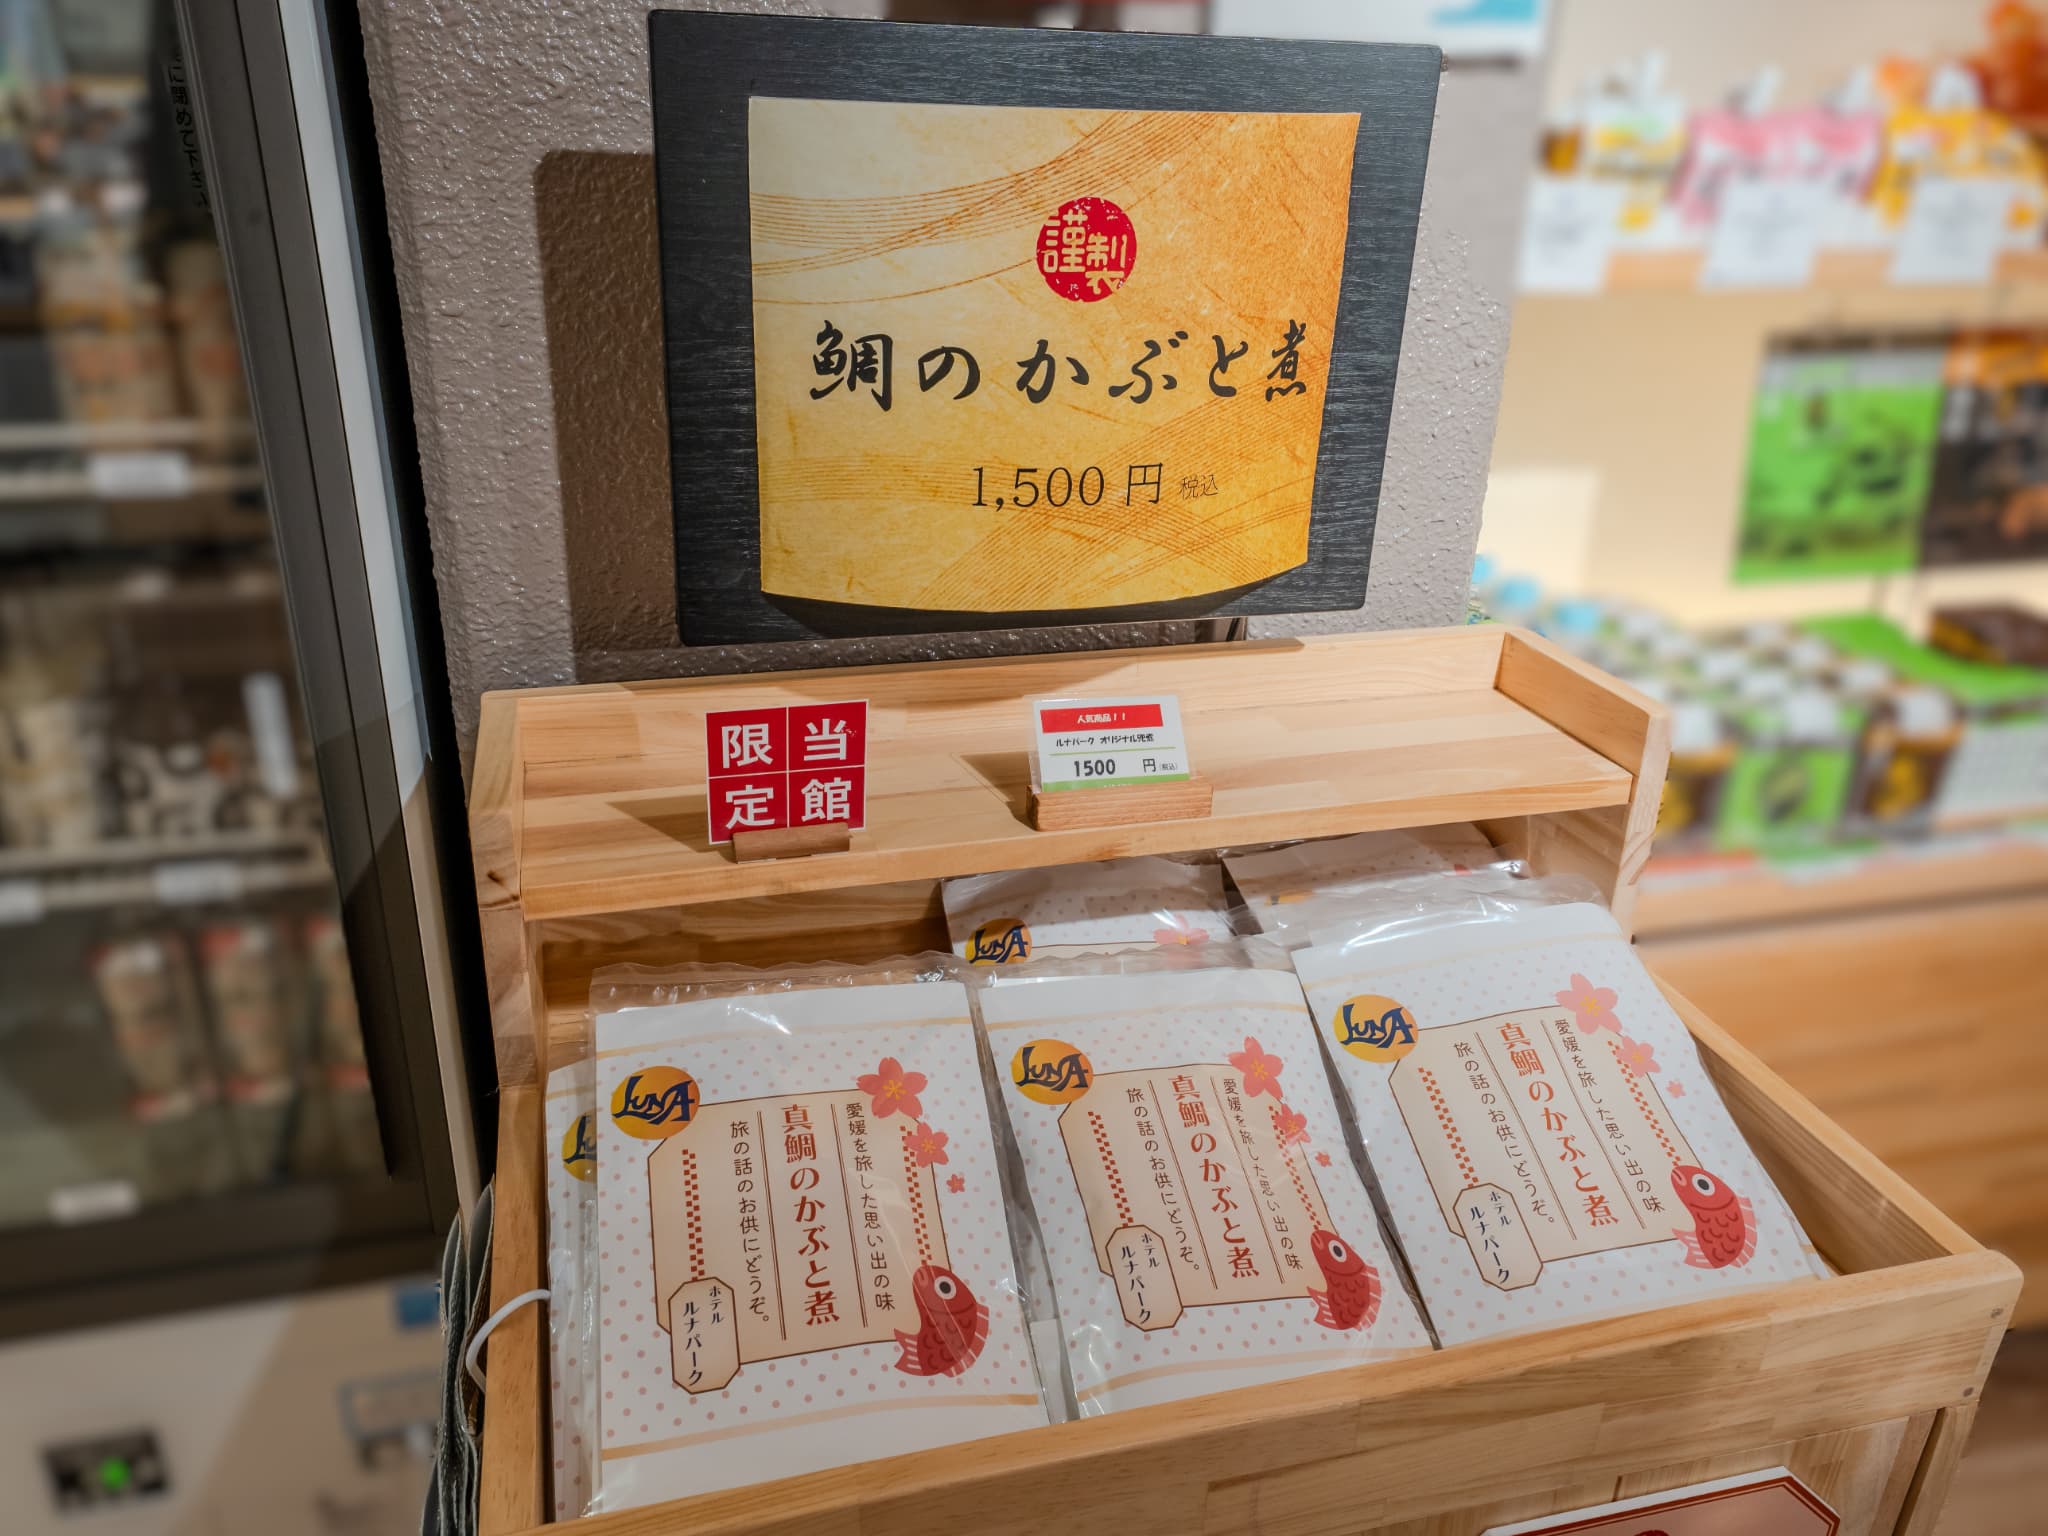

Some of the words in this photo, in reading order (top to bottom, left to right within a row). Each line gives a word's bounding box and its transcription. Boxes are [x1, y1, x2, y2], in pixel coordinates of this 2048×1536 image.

[1039, 207, 1127, 296] 謹製
[810, 319, 1308, 411] 鯛のかぶと煮
[972, 466, 1104, 512] 1,500
[1126, 463, 1163, 506] 円
[1179, 474, 1218, 499] 税込
[1073, 759, 1116, 777] 1500
[1143, 758, 1157, 773] 円
[1014, 1046, 1089, 1092] LUNA
[1341, 1002, 1417, 1049] LUNA
[612, 1075, 695, 1125] LUNA
[1452, 1041, 1556, 1225] 旅の話のお供にどうぞ。
[1496, 1021, 1619, 1228] 真鯛のかぶと煮
[1553, 1018, 1664, 1214] 愛媛を旅した思い出の味
[780, 1103, 841, 1326] 真鯛のかぶと煮
[845, 1102, 896, 1311] 愛媛を旅した思い出の味
[1125, 1087, 1200, 1272] 旅の話のお供にどうぞ。
[1167, 1074, 1260, 1279] 真鯛のかぶと煮
[1223, 1077, 1304, 1271] 愛媛を旅した思い出の味
[1488, 1190, 1513, 1228] ホテル
[729, 1120, 770, 1322] 旅の話のお供にどうぞ。
[1140, 1232, 1161, 1269] ホテル
[1469, 1206, 1511, 1285] ルナパーク
[708, 1284, 723, 1325] ホテル
[1120, 1245, 1152, 1326] ルナパーク
[682, 1301, 703, 1387] ルナパーク
